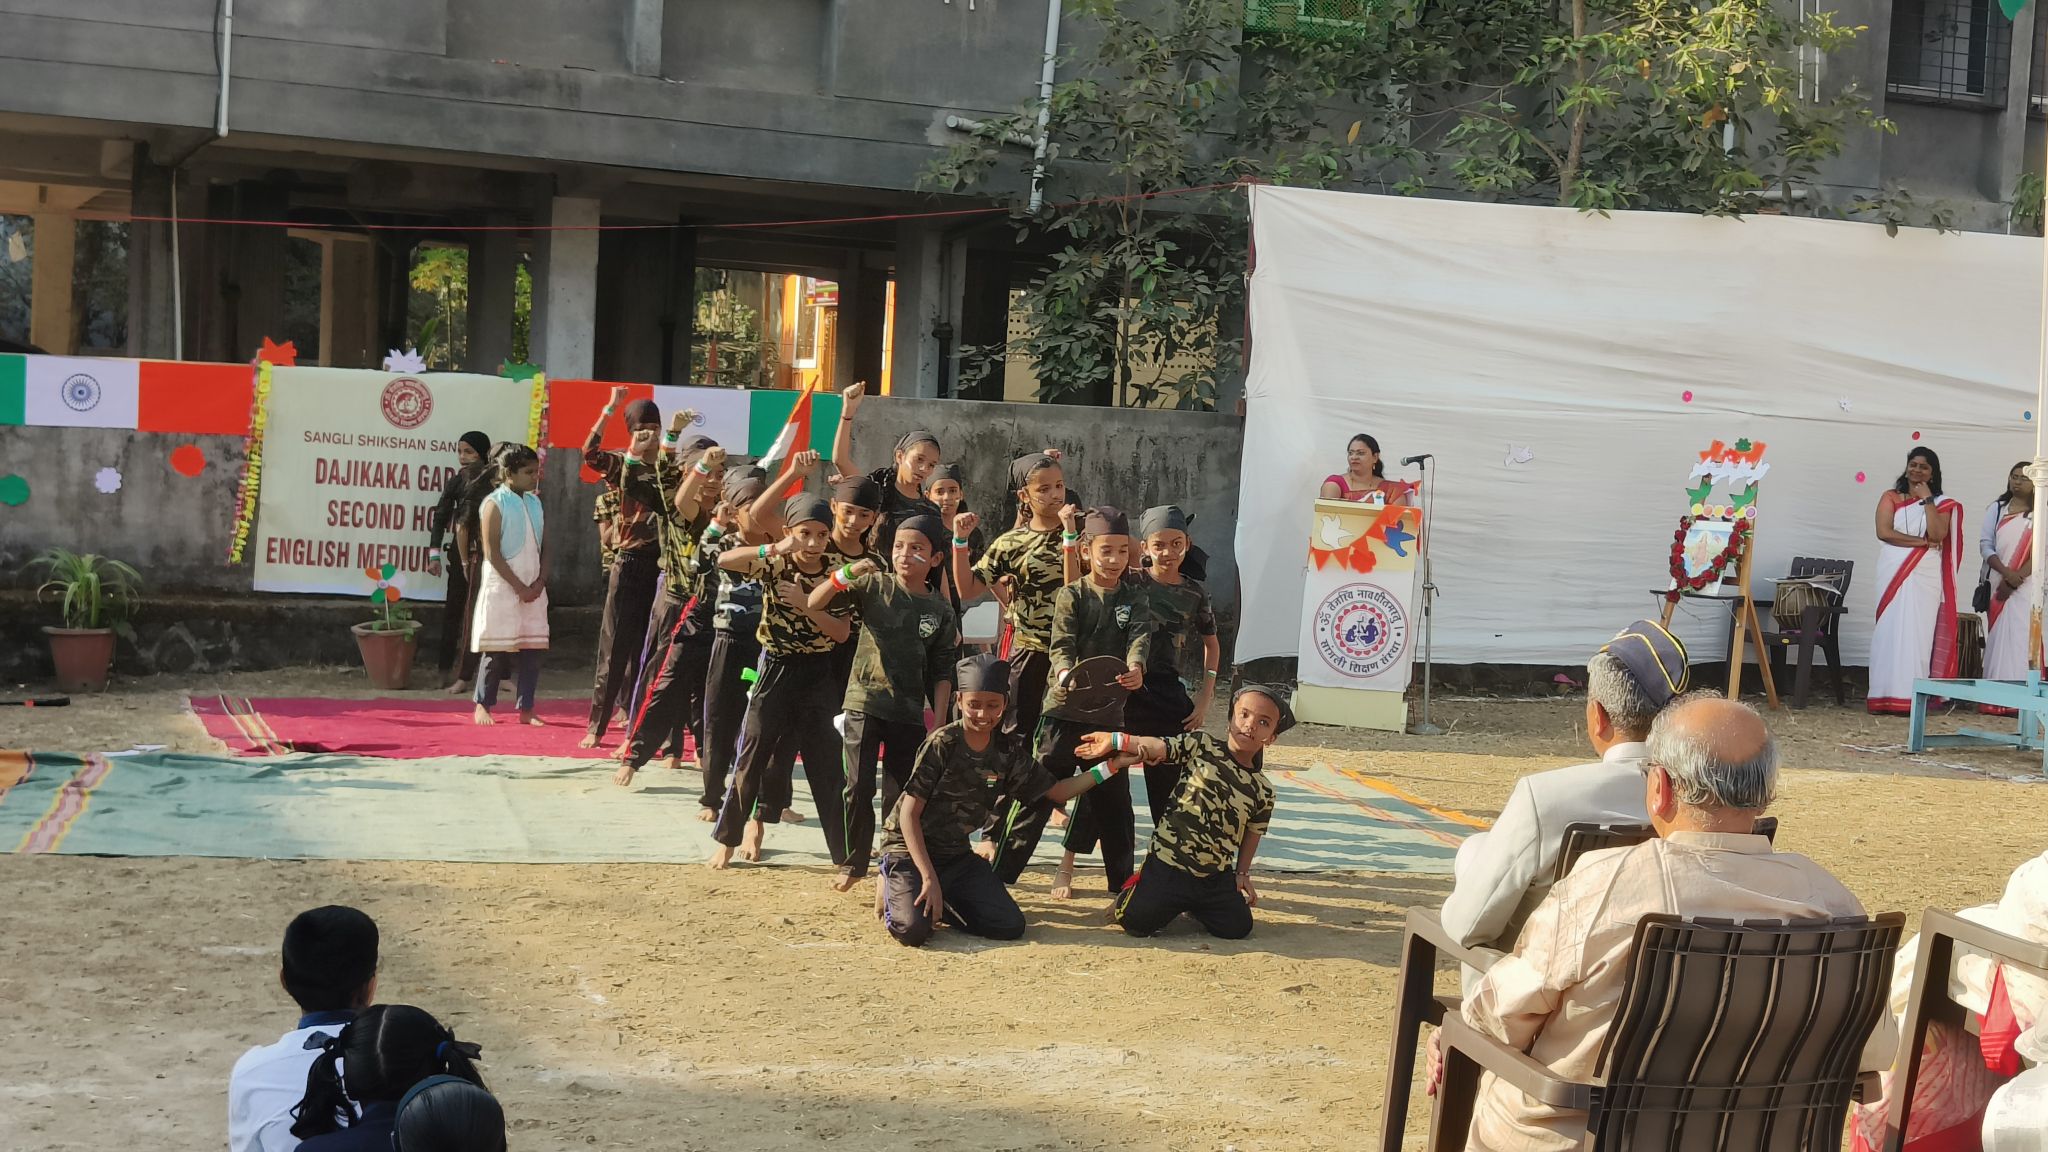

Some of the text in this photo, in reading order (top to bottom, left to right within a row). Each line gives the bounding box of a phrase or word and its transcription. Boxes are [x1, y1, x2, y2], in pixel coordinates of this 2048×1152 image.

[304, 430, 458, 453] SANGLI SHIKSHAN SAN
[315, 457, 411, 491] DAJIKAKA
[327, 500, 406, 531] SECOND
[266, 537, 350, 568] ENGLISH
